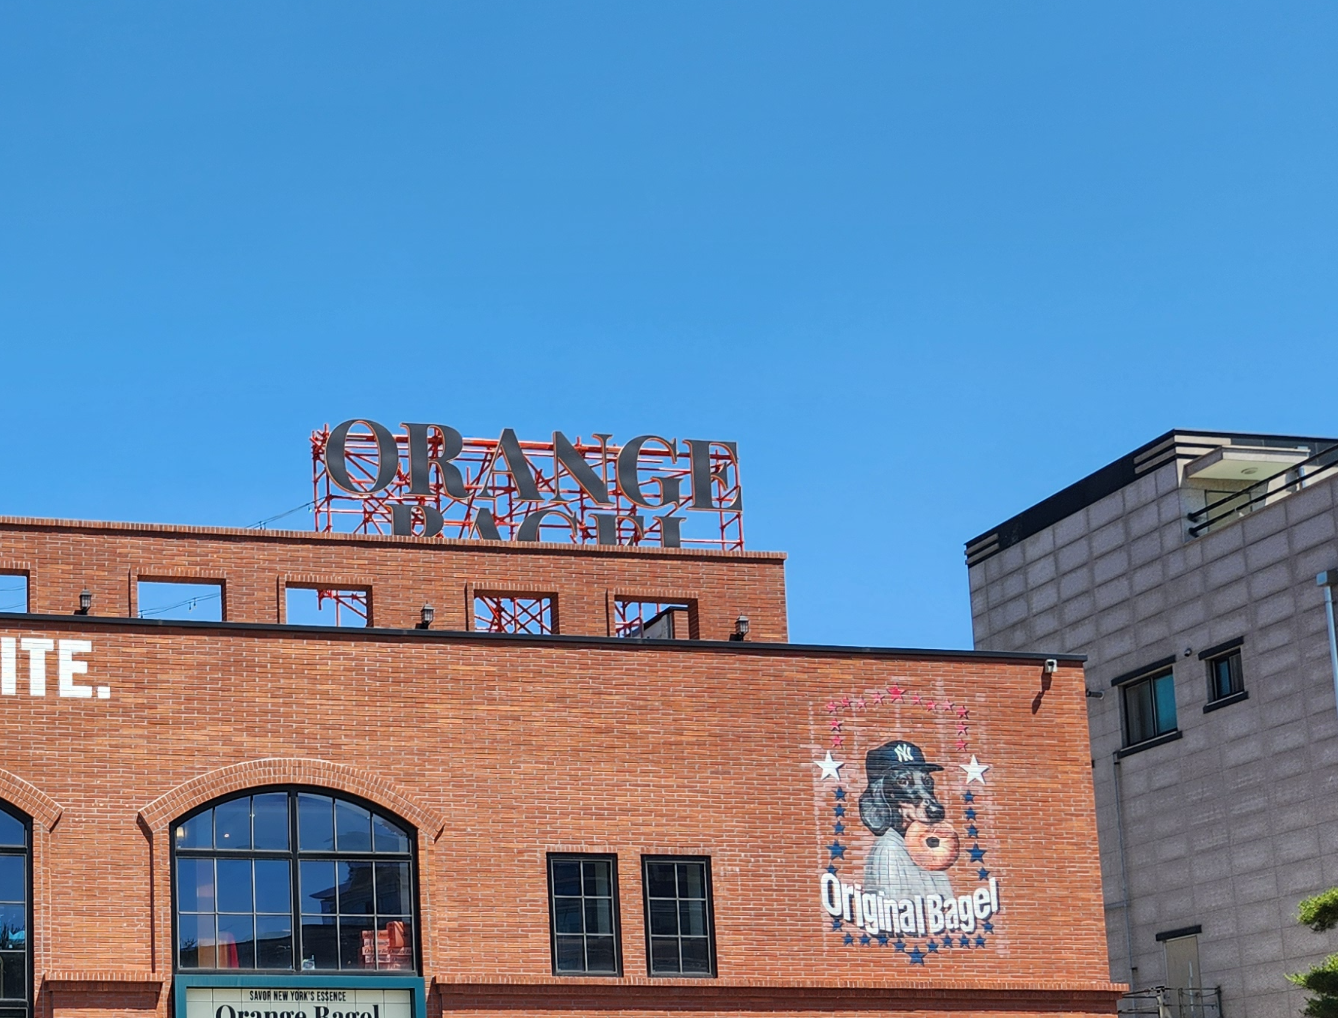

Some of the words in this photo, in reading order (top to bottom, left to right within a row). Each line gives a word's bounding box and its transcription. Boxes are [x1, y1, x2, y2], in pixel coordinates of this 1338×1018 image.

[324, 418, 743, 513] ORANGE
[820, 872, 927, 936] Original
[926, 876, 1000, 935] Bagel
[249, 990, 272, 1002] SAVOR
[273, 990, 289, 1002] NEW
[290, 990, 316, 1002] YORK'S
[316, 991, 347, 1002] ESSENCE
